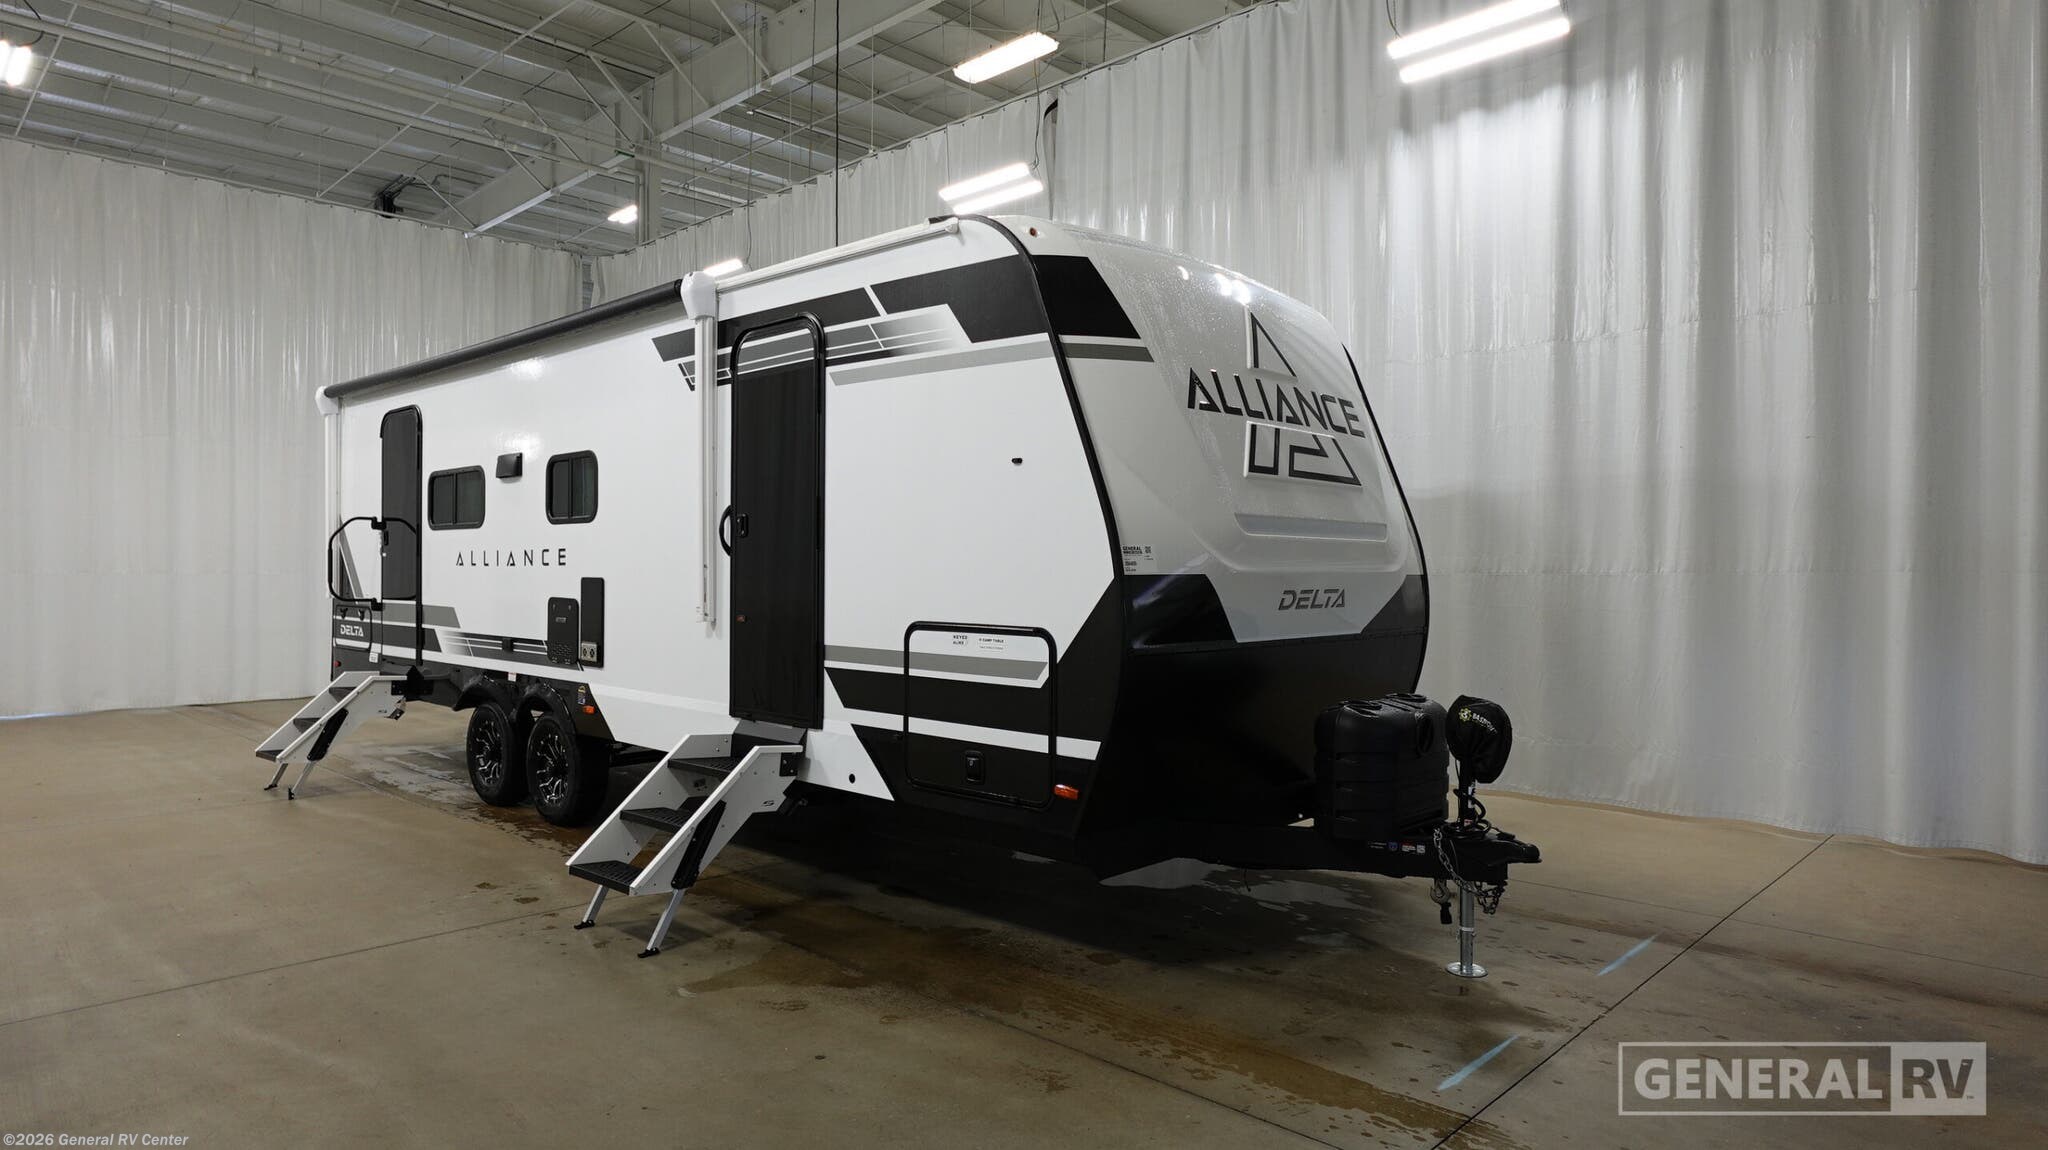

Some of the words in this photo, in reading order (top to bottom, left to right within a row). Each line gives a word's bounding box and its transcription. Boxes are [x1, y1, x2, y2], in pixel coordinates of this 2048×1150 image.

[1187, 367, 1366, 438] ALLIANCE
[455, 548, 567, 567] ALLIANCE
[1278, 588, 1346, 611] DELTA
[340, 624, 364, 637] DELTA
